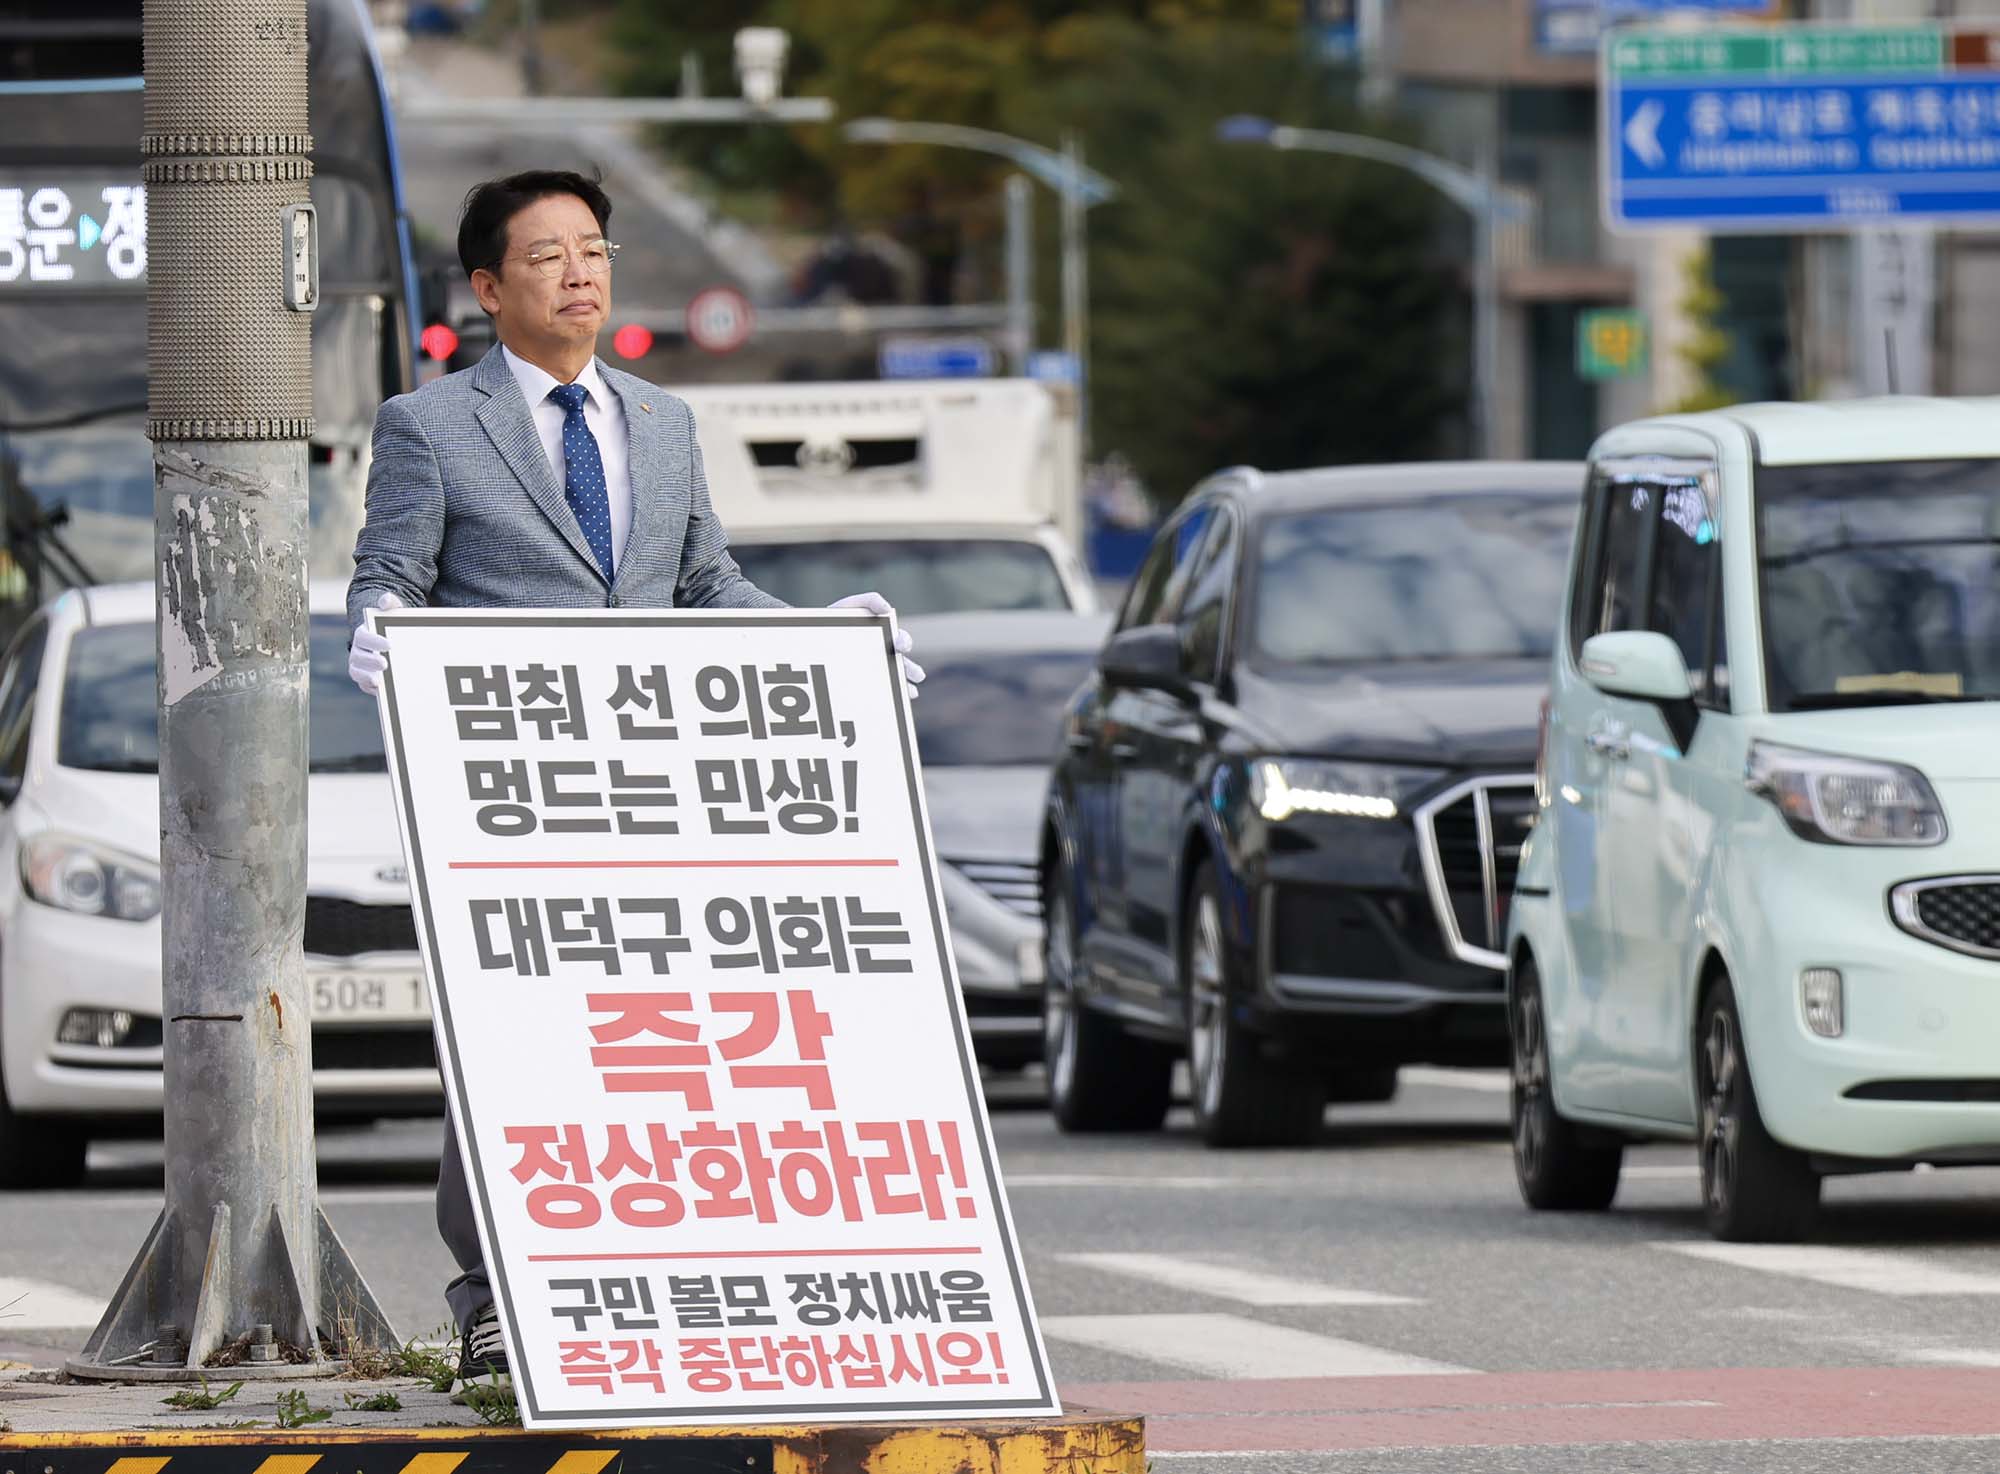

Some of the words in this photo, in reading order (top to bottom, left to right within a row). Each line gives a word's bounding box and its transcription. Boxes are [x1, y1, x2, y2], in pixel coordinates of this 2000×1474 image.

[444, 664, 588, 740] 멈춰
[606, 665, 678, 740] 선
[695, 664, 856, 748] 의회,
[464, 760, 679, 836] 멍드는
[695, 759, 859, 834] 민생!
[469, 898, 691, 976] 대덕구
[705, 896, 913, 973] 의회는
[586, 990, 836, 1111] 즉각
[503, 1120, 977, 1229] 정상화하라!
[548, 1277, 659, 1331] 구민
[668, 1275, 778, 1328] 볼모
[784, 1270, 993, 1326] 정치싸움
[559, 1339, 665, 1394] 즉각
[679, 1332, 1009, 1392] 중단하십시오!
